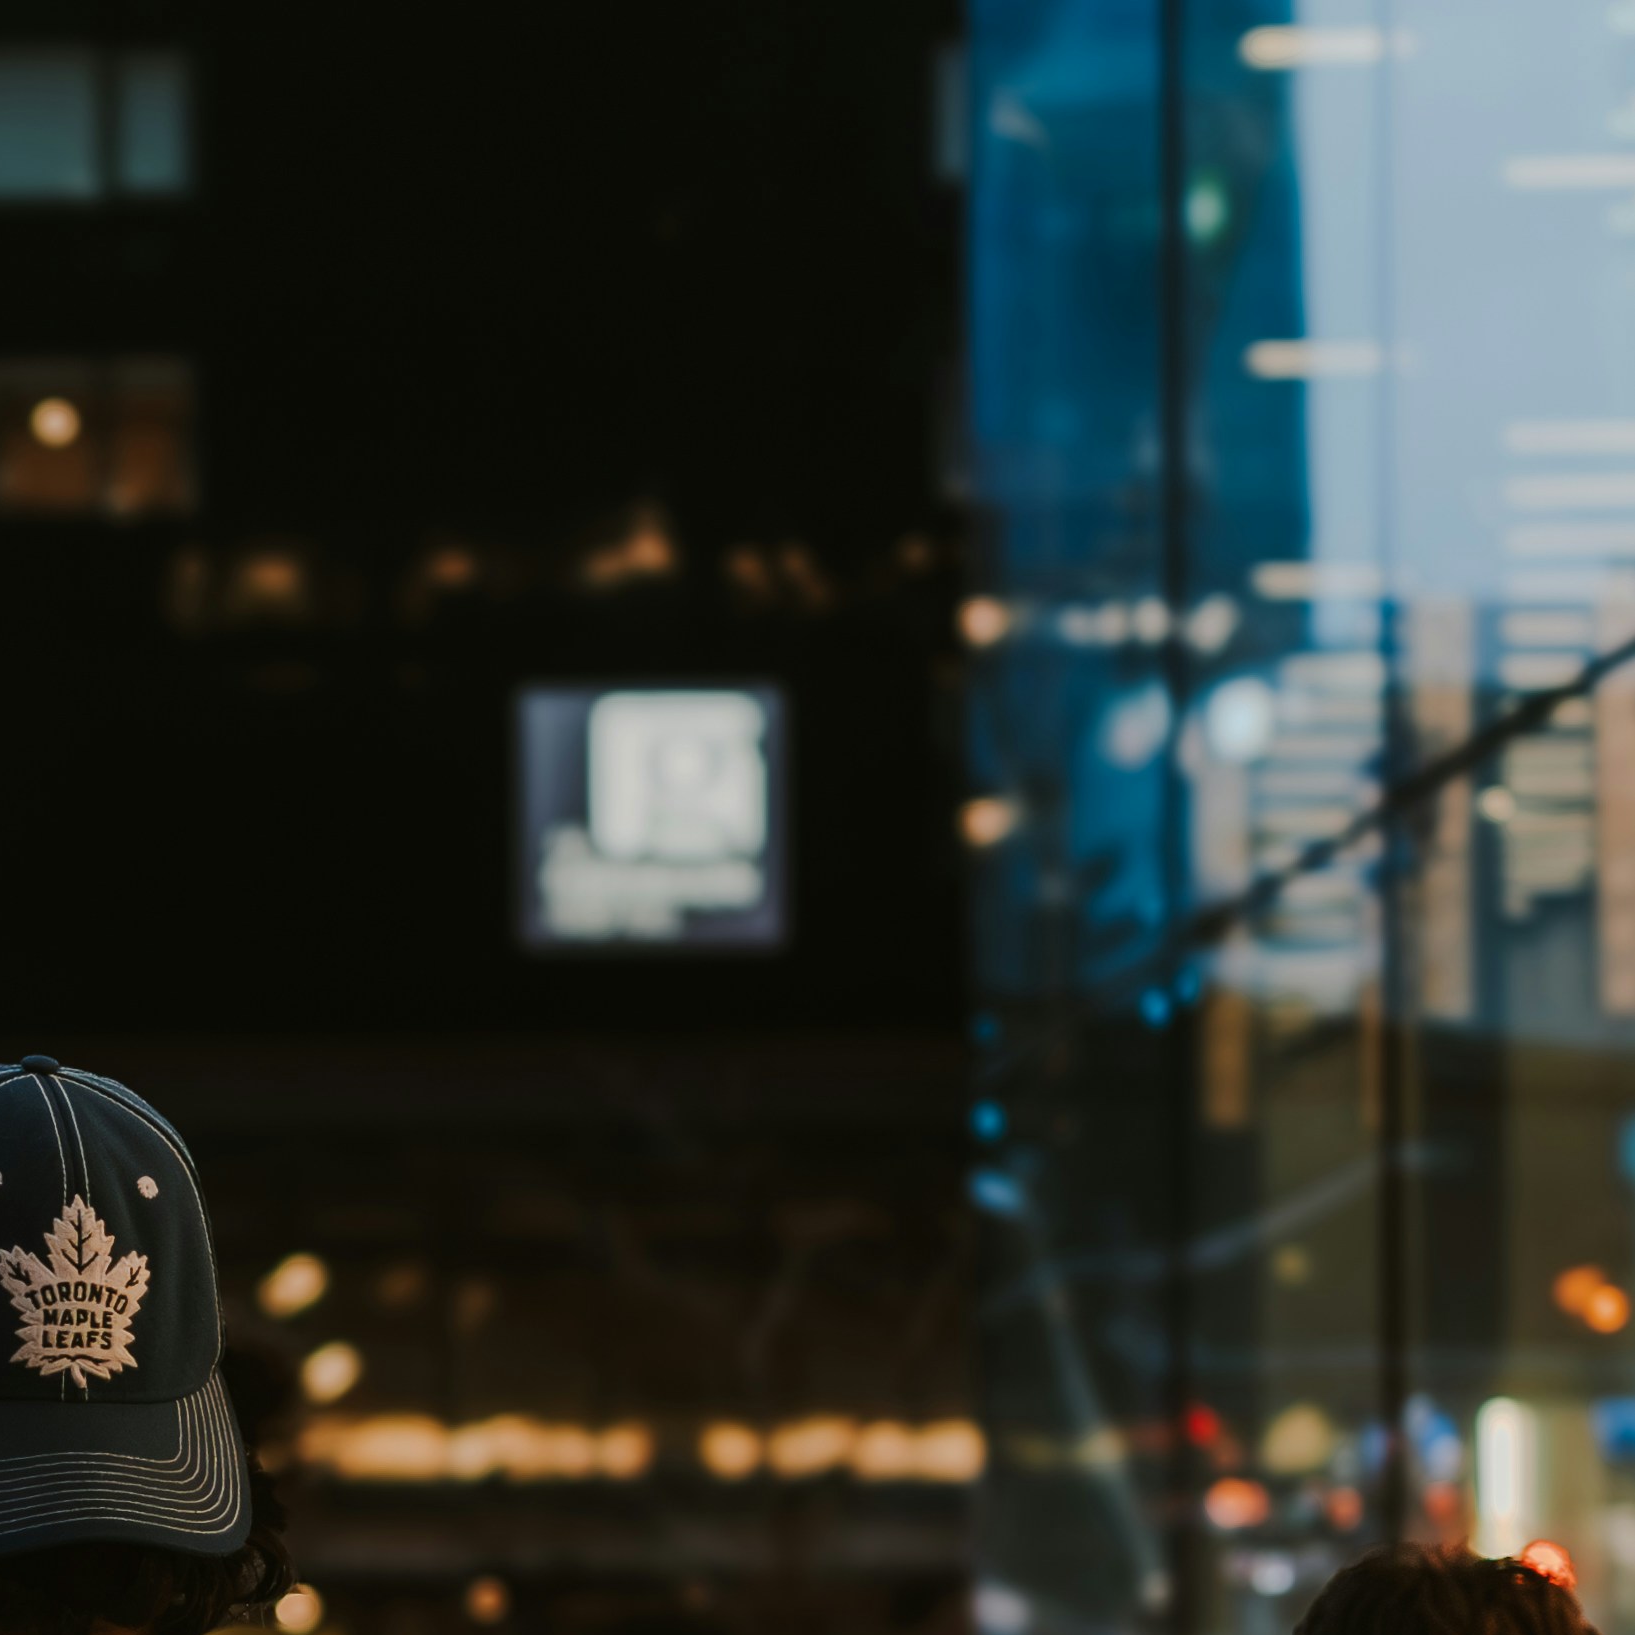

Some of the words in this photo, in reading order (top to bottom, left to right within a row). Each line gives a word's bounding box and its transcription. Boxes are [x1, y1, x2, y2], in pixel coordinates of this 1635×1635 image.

[25, 1281, 128, 1315] TORONTO
[42, 1308, 113, 1329] MAPLE
[42, 1330, 113, 1350] LEAFS
